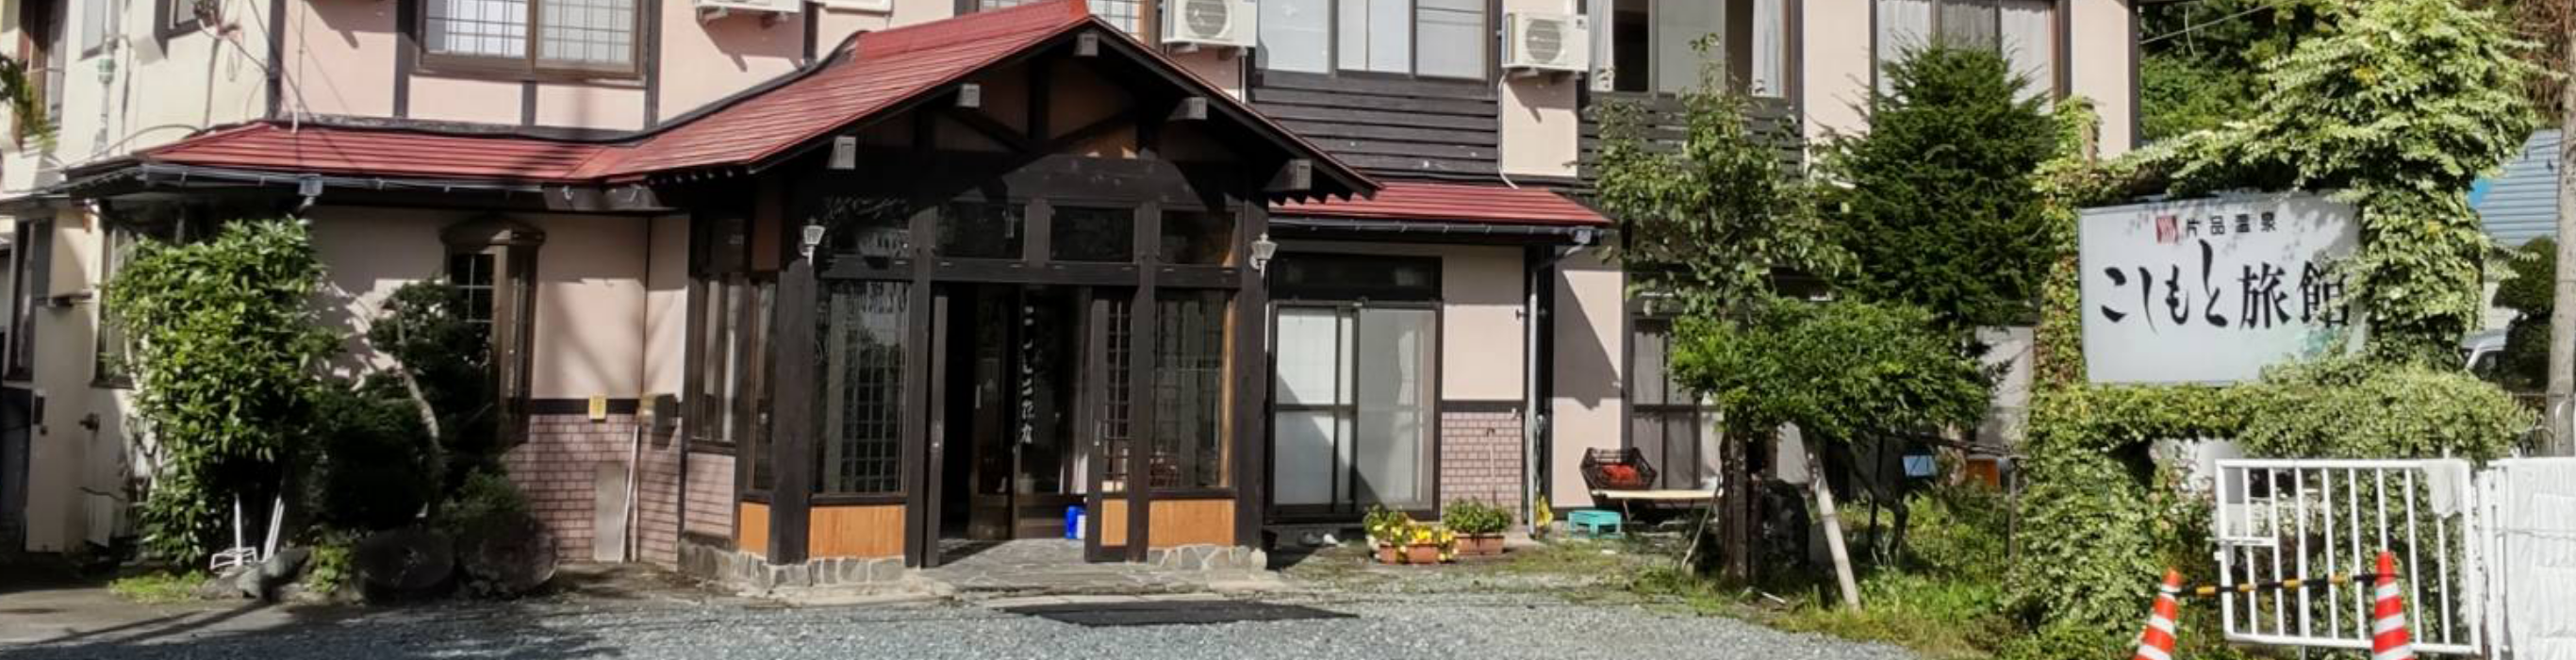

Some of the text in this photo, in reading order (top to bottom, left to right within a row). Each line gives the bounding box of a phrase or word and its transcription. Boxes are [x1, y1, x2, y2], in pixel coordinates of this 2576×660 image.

[2101, 239, 2350, 333] こしもと旅館
